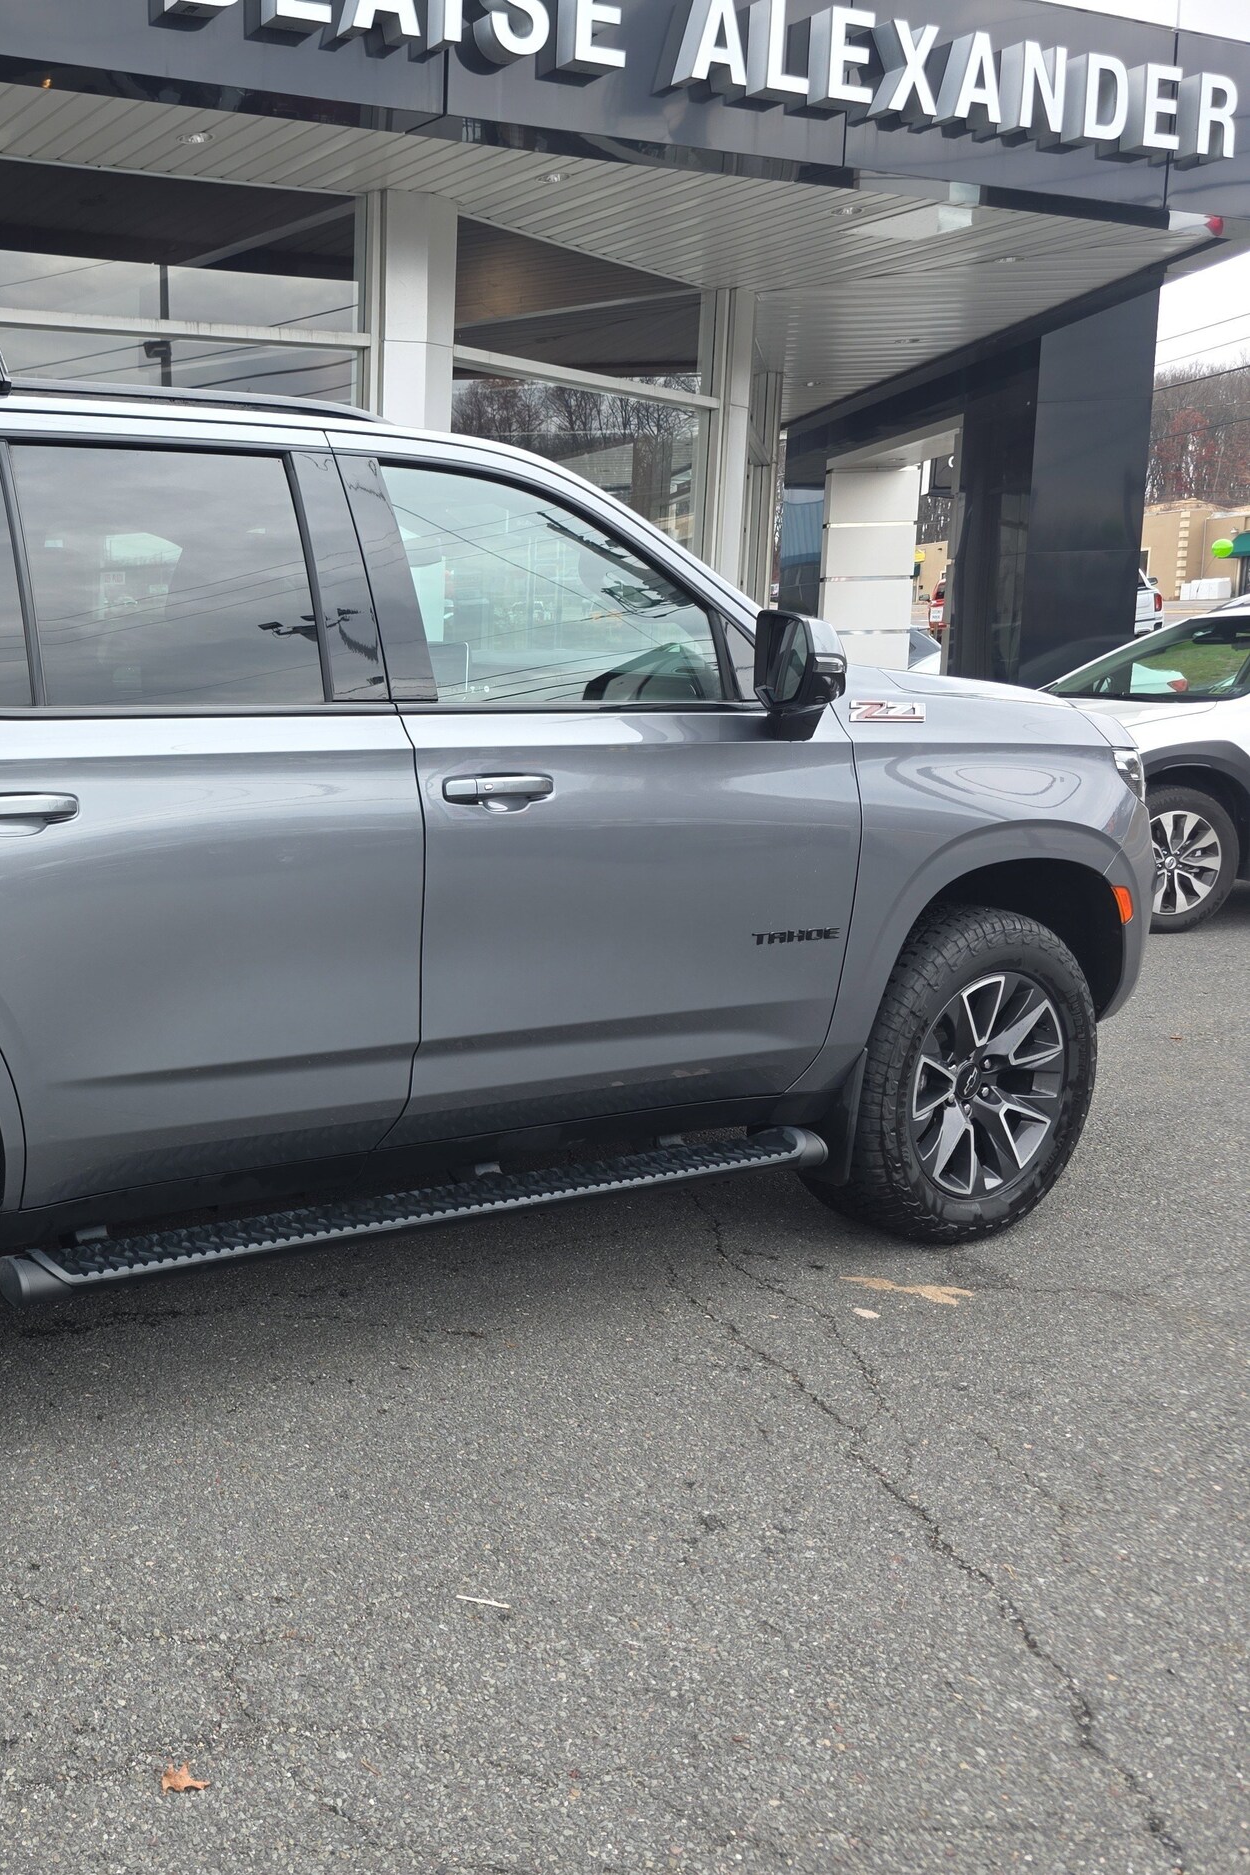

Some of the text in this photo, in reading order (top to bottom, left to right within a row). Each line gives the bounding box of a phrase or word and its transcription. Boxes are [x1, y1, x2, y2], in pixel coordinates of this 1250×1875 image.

[673, 0, 1238, 158] ALEXANDER
[849, 699, 927, 723] Z71
[751, 926, 841, 946] TAHOE
